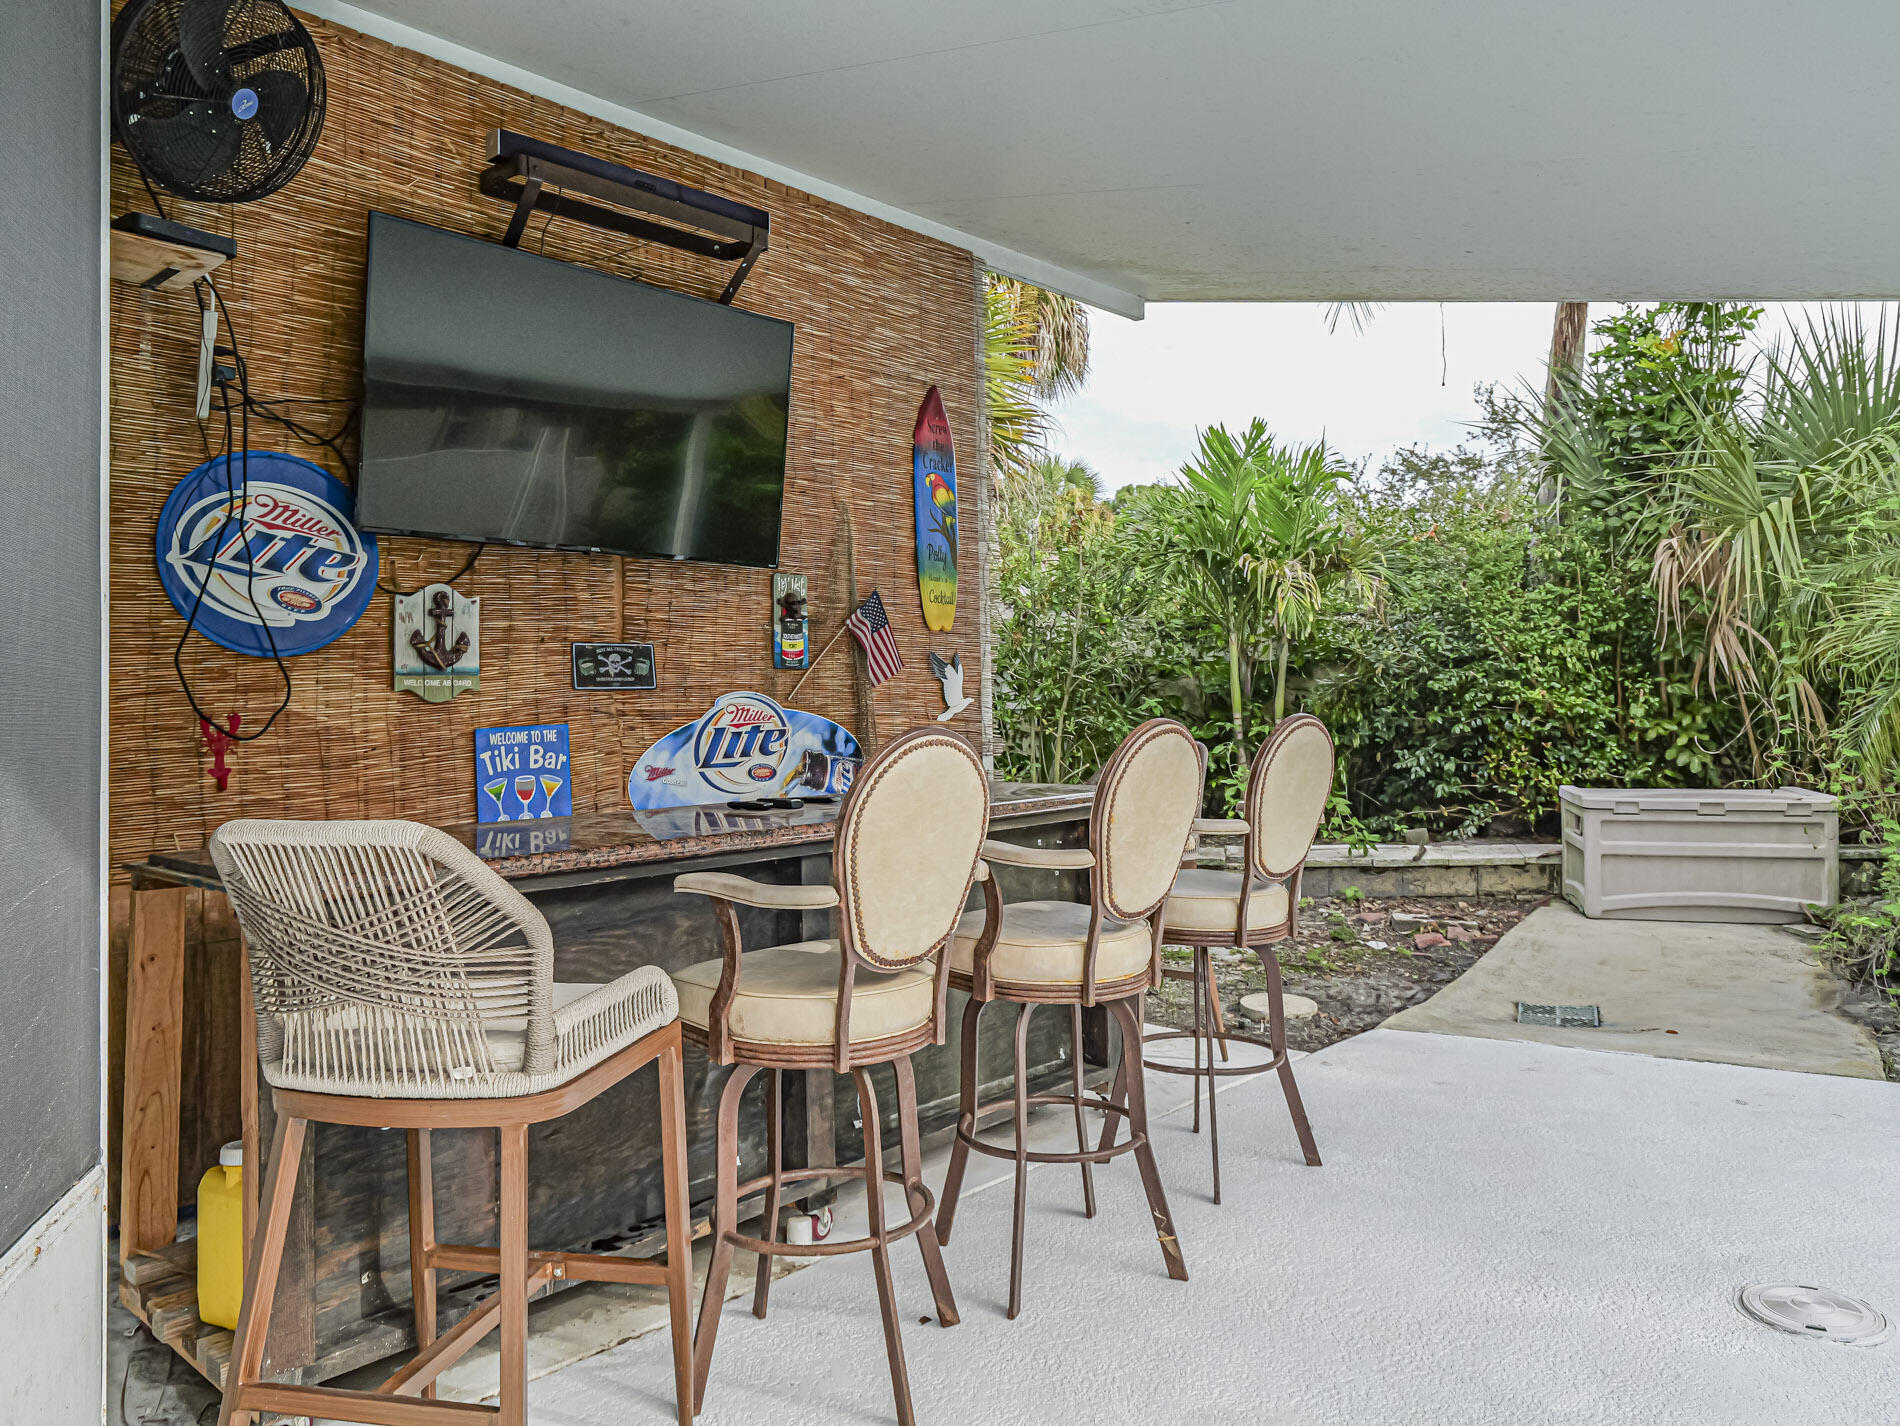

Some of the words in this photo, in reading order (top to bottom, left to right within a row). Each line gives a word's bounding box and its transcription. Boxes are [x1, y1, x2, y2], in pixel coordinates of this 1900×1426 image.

[922, 452, 954, 473] Cracker
[254, 493, 343, 537] Miller
[180, 517, 360, 583] Lite
[927, 543, 947, 571] Polly
[403, 679, 441, 687] WELCOME
[442, 679, 472, 687] ABOARD
[725, 703, 776, 723] Miller
[489, 731, 529, 745] WELCOME
[530, 730, 541, 743] TO
[543, 729, 558, 743] THE
[699, 724, 789, 769] Lite
[479, 745, 520, 776] Tiki
[529, 745, 567, 770] Bar
[644, 765, 676, 779] Miller
